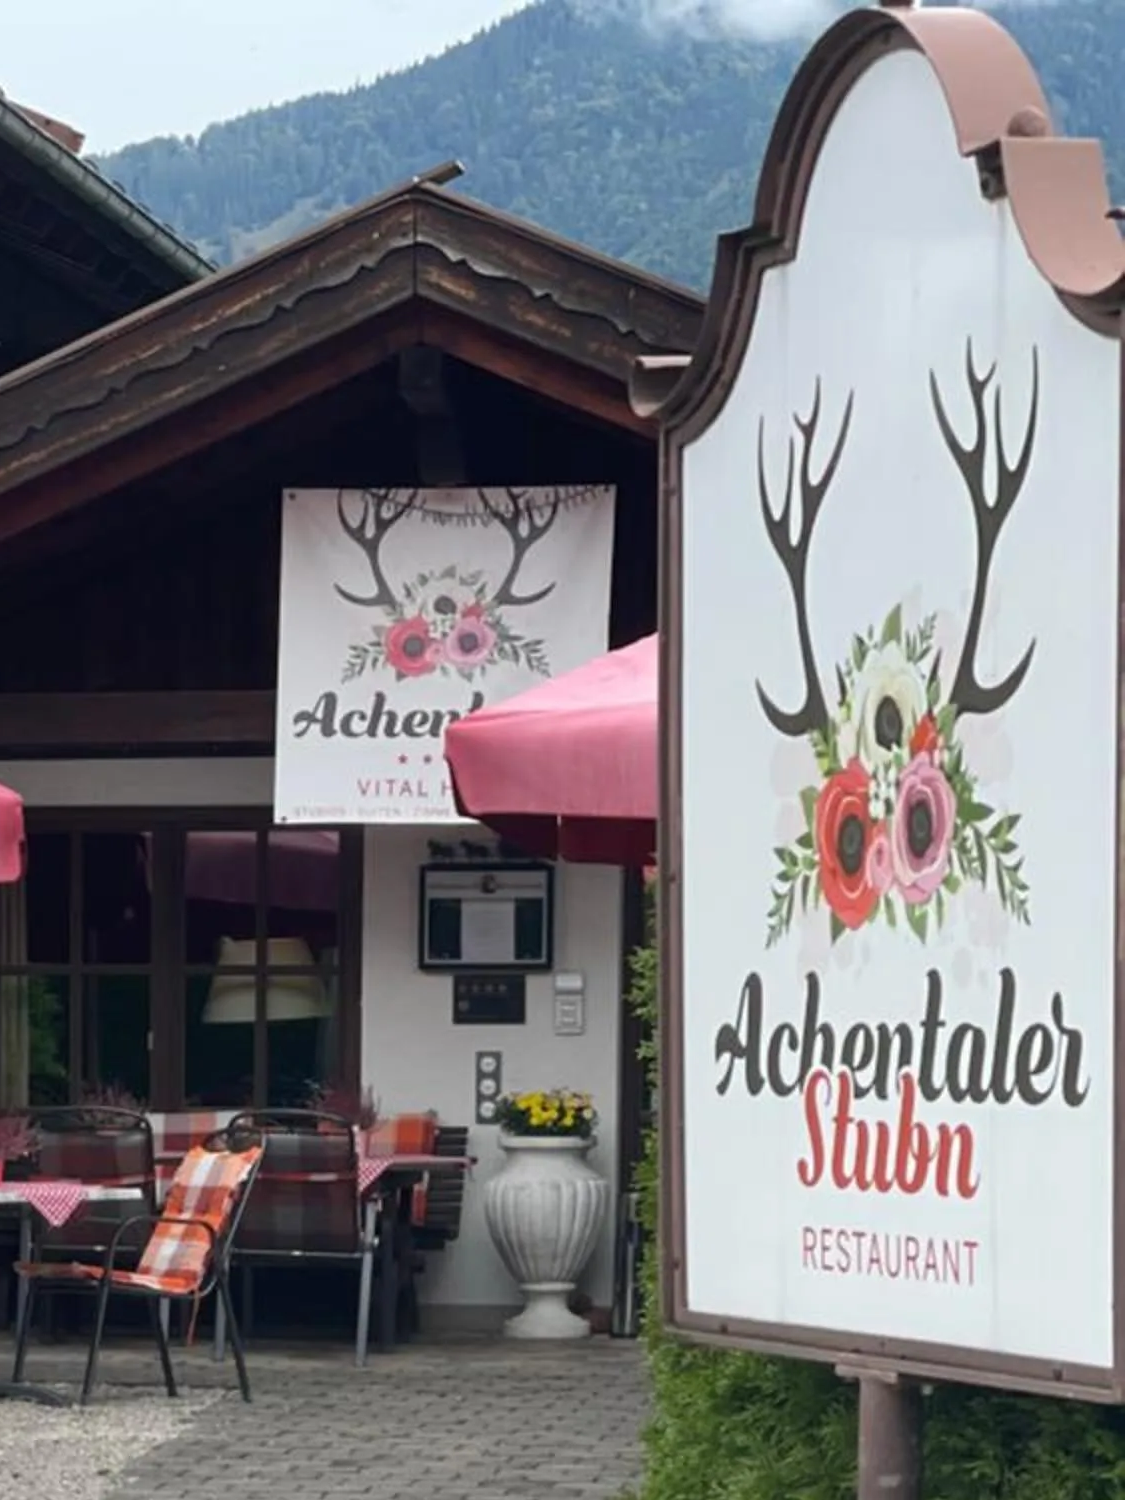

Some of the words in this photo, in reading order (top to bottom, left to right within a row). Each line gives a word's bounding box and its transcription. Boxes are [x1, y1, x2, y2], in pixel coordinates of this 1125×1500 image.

[357, 779, 429, 798] VITAL
[715, 967, 1090, 1107] Achentaler
[797, 1069, 979, 1200] Stubn
[802, 1226, 979, 1286] RESTAURANT
